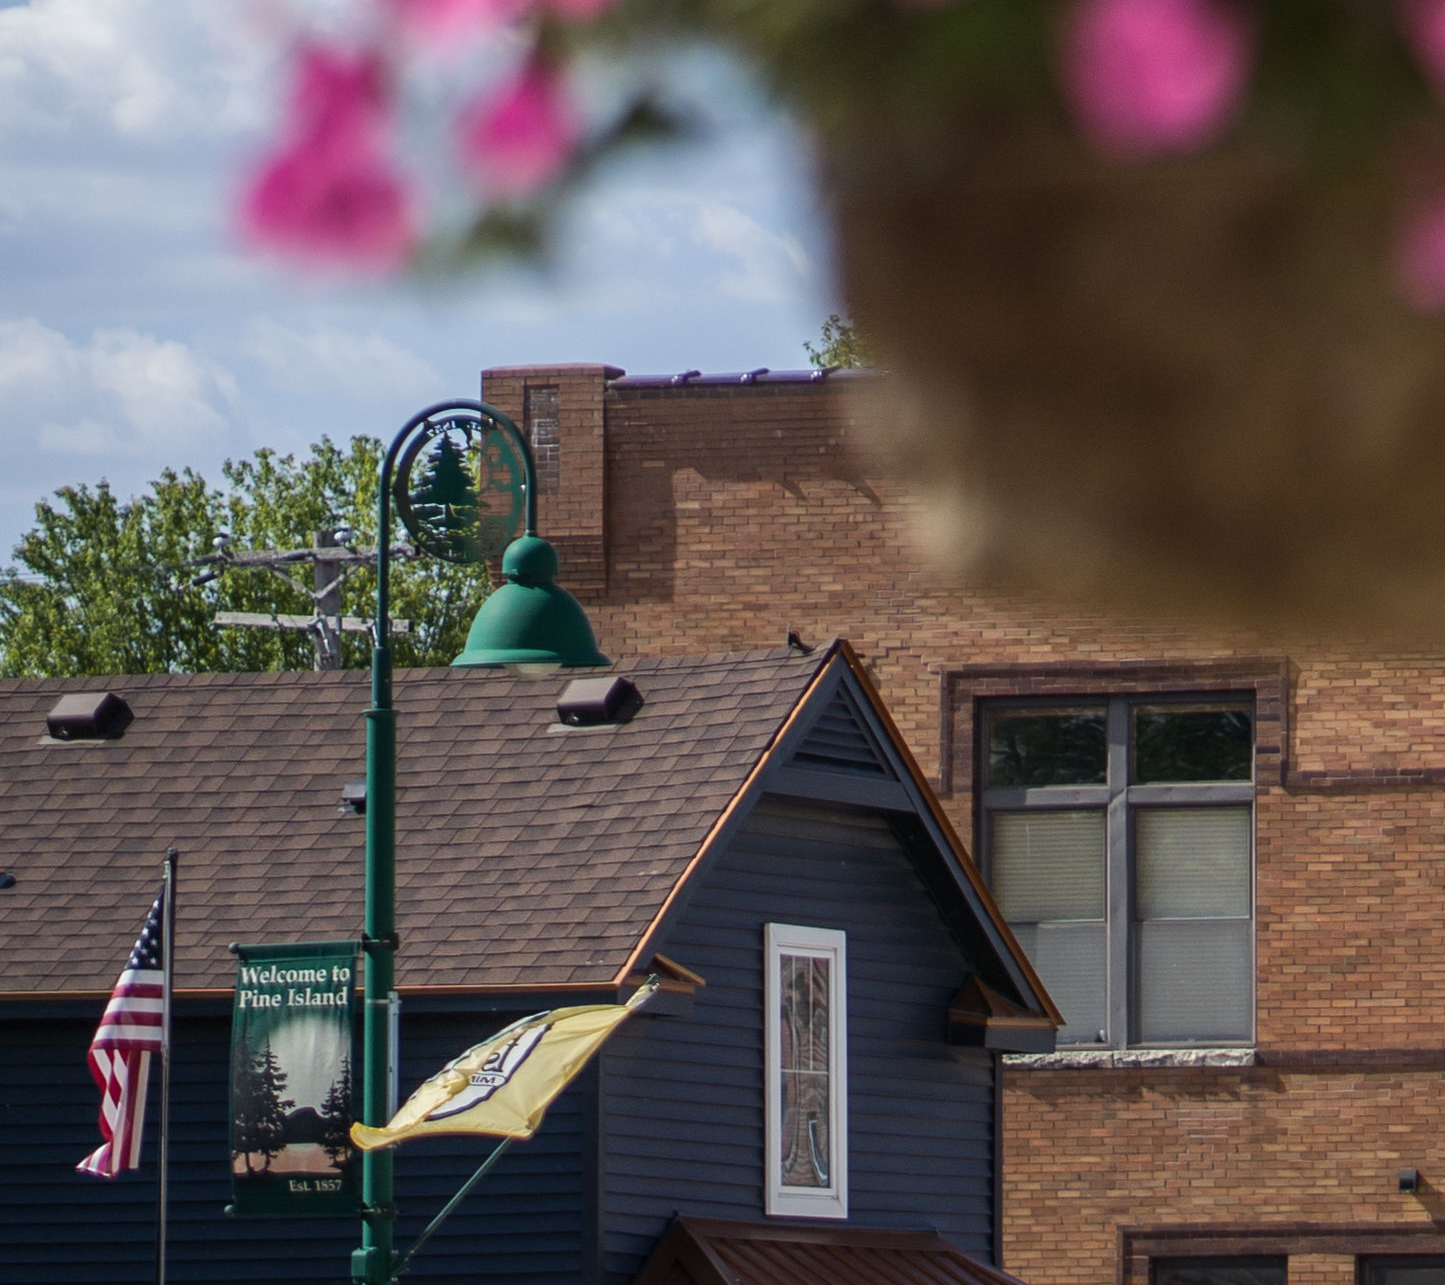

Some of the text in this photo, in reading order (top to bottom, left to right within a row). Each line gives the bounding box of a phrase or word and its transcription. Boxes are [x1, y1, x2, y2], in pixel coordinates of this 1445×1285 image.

[242, 965, 350, 984] Welcome to
[239, 986, 348, 1008] Pine Island
[288, 1179, 342, 1192] Est. 1857
